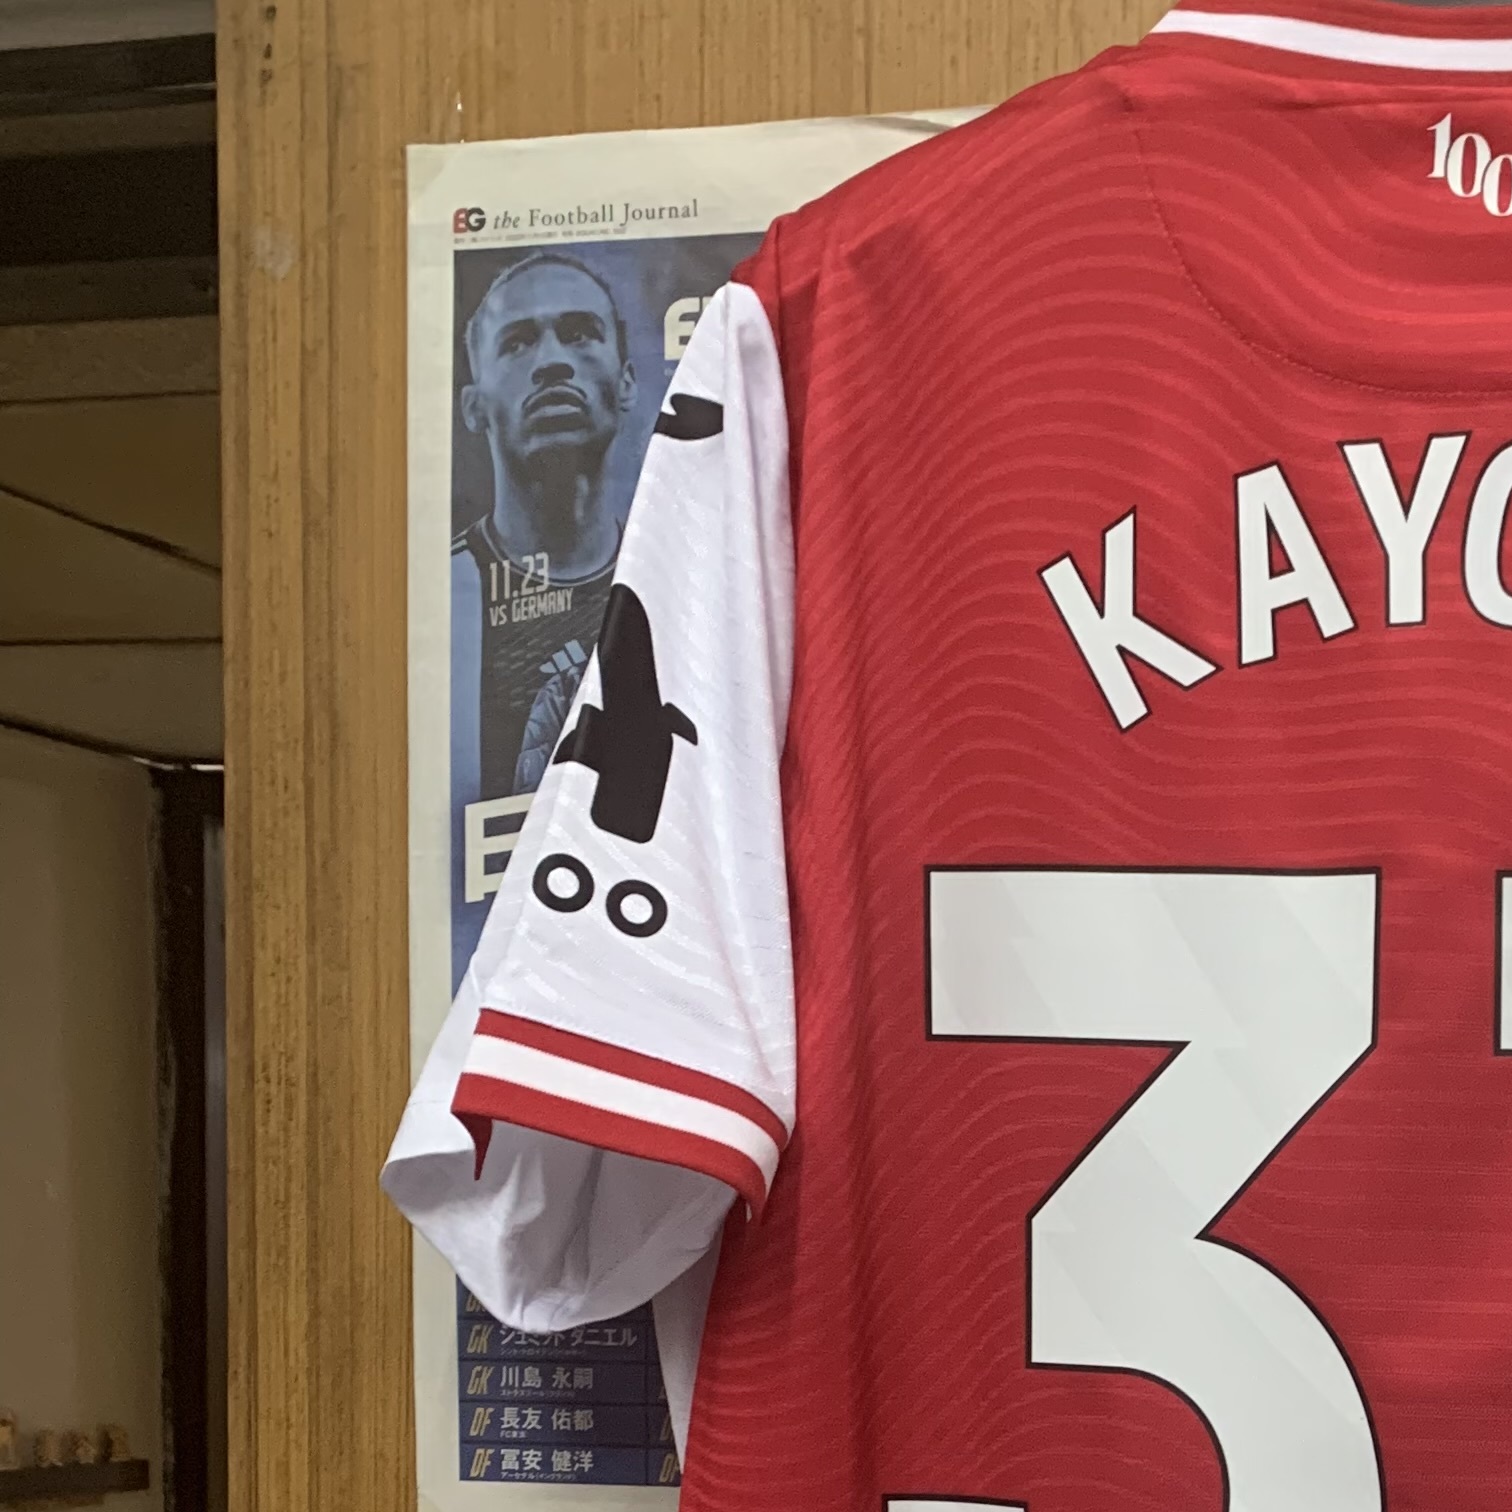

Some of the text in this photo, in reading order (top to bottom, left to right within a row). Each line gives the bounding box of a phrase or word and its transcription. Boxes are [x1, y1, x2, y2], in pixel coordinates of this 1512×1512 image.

[493, 212, 520, 230] the
[528, 204, 614, 229] Football
[623, 199, 699, 226] Journal
[489, 551, 549, 602] 11.23
[489, 587, 573, 627] VS GERMANY
[467, 1324, 494, 1354] GK
[467, 1365, 495, 1395] GK
[500, 1365, 542, 1389] 川島
[469, 1407, 594, 1437] DF 長友 佑都
[469, 1448, 495, 1478] DF
[551, 1449, 594, 1473] 健洋
